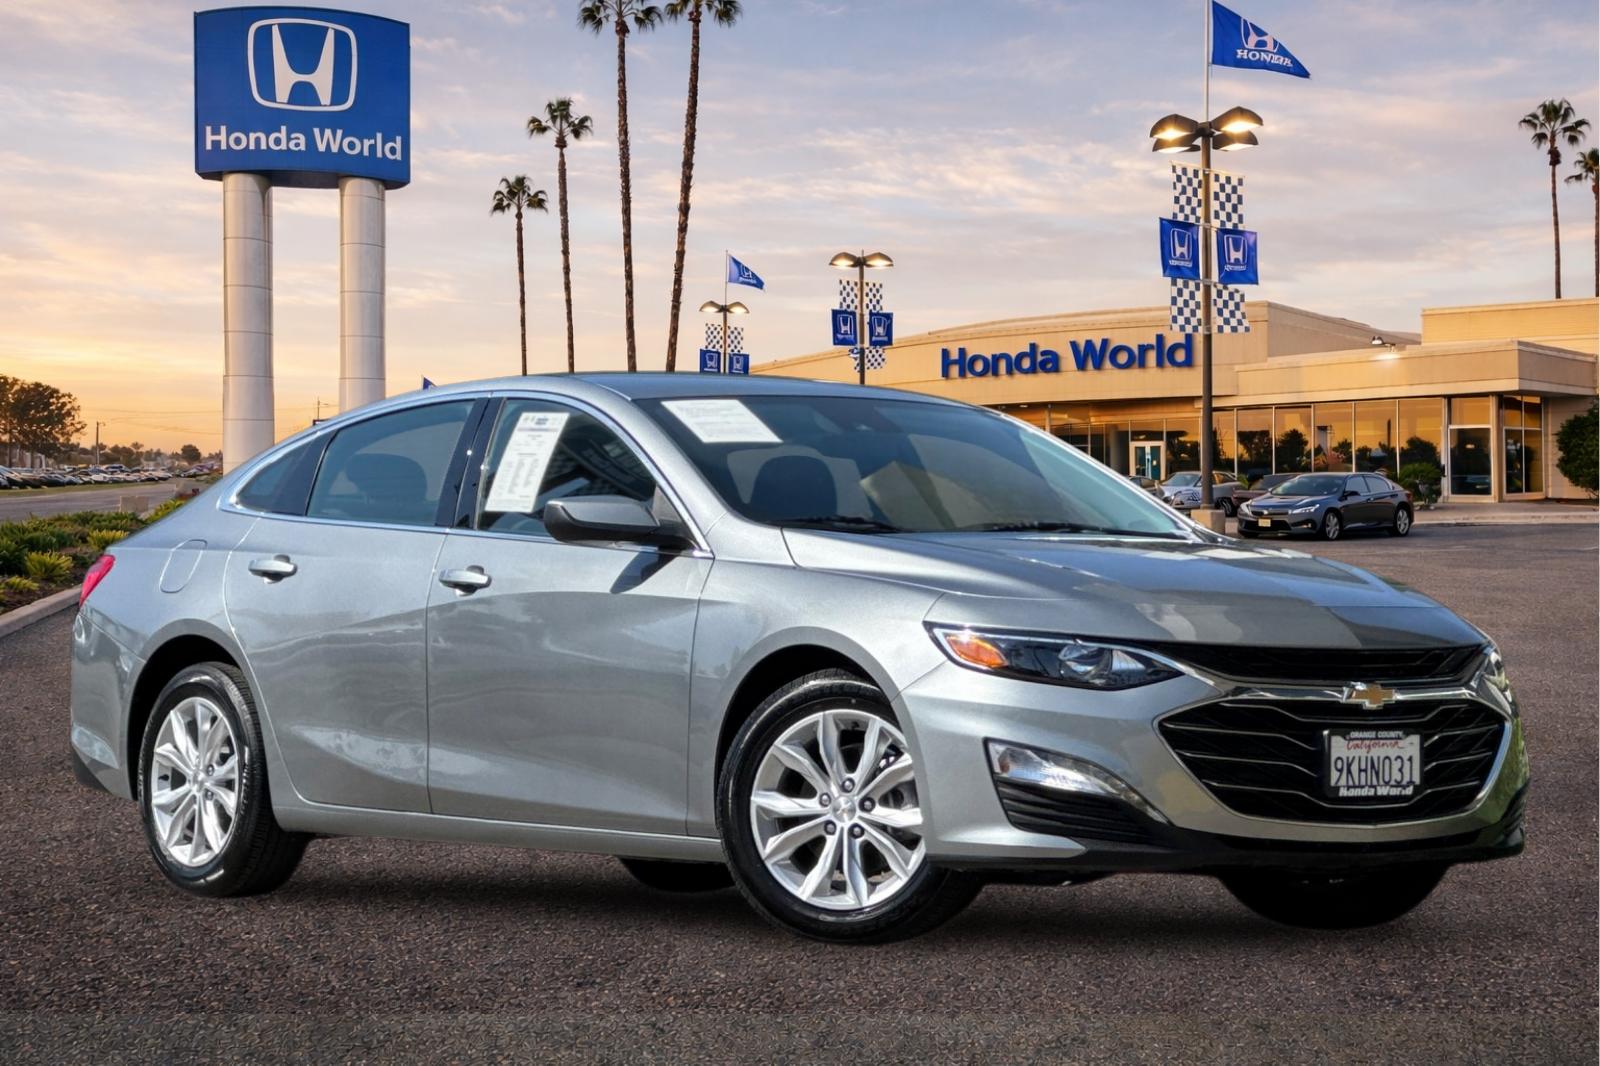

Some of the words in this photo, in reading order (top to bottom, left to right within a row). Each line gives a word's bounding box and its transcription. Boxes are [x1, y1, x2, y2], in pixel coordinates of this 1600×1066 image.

[205, 126, 306, 151] Honda
[313, 128, 402, 160] World
[941, 342, 1061, 379] Honda
[1069, 333, 1193, 371] World
[1346, 740, 1406, 753] California
[1334, 755, 1416, 785] 9KHN031
[1339, 786, 1375, 797] Honda
[1376, 786, 1414, 796] World
